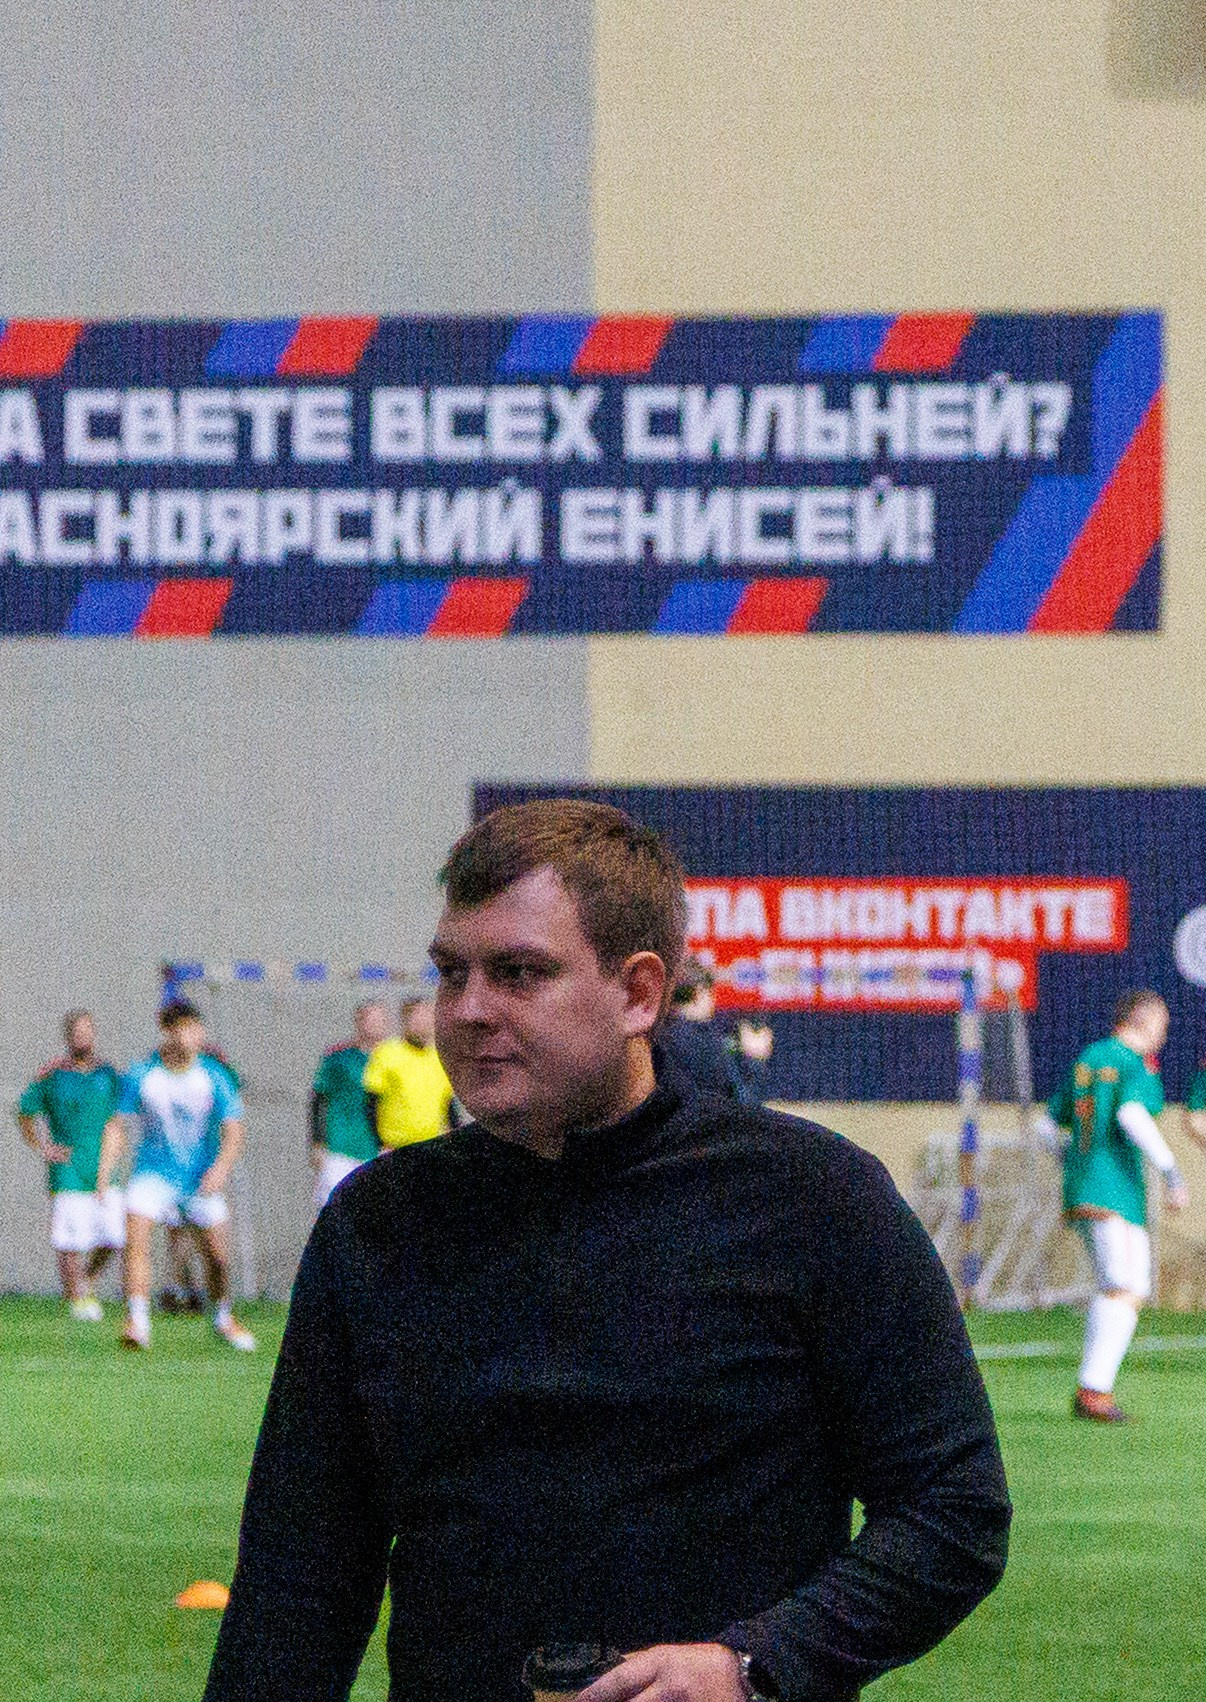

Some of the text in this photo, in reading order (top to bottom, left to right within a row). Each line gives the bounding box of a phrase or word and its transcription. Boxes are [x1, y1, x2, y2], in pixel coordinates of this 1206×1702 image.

[64, 386, 352, 464] СВЕТЕ
[371, 386, 603, 463] ВСЕХ
[622, 372, 1072, 462] СИЛЬНЕЙ?
[560, 476, 936, 563] ЕНИСЕЙ!
[779, 886, 1113, 941] ВКОНТАКТЕ
